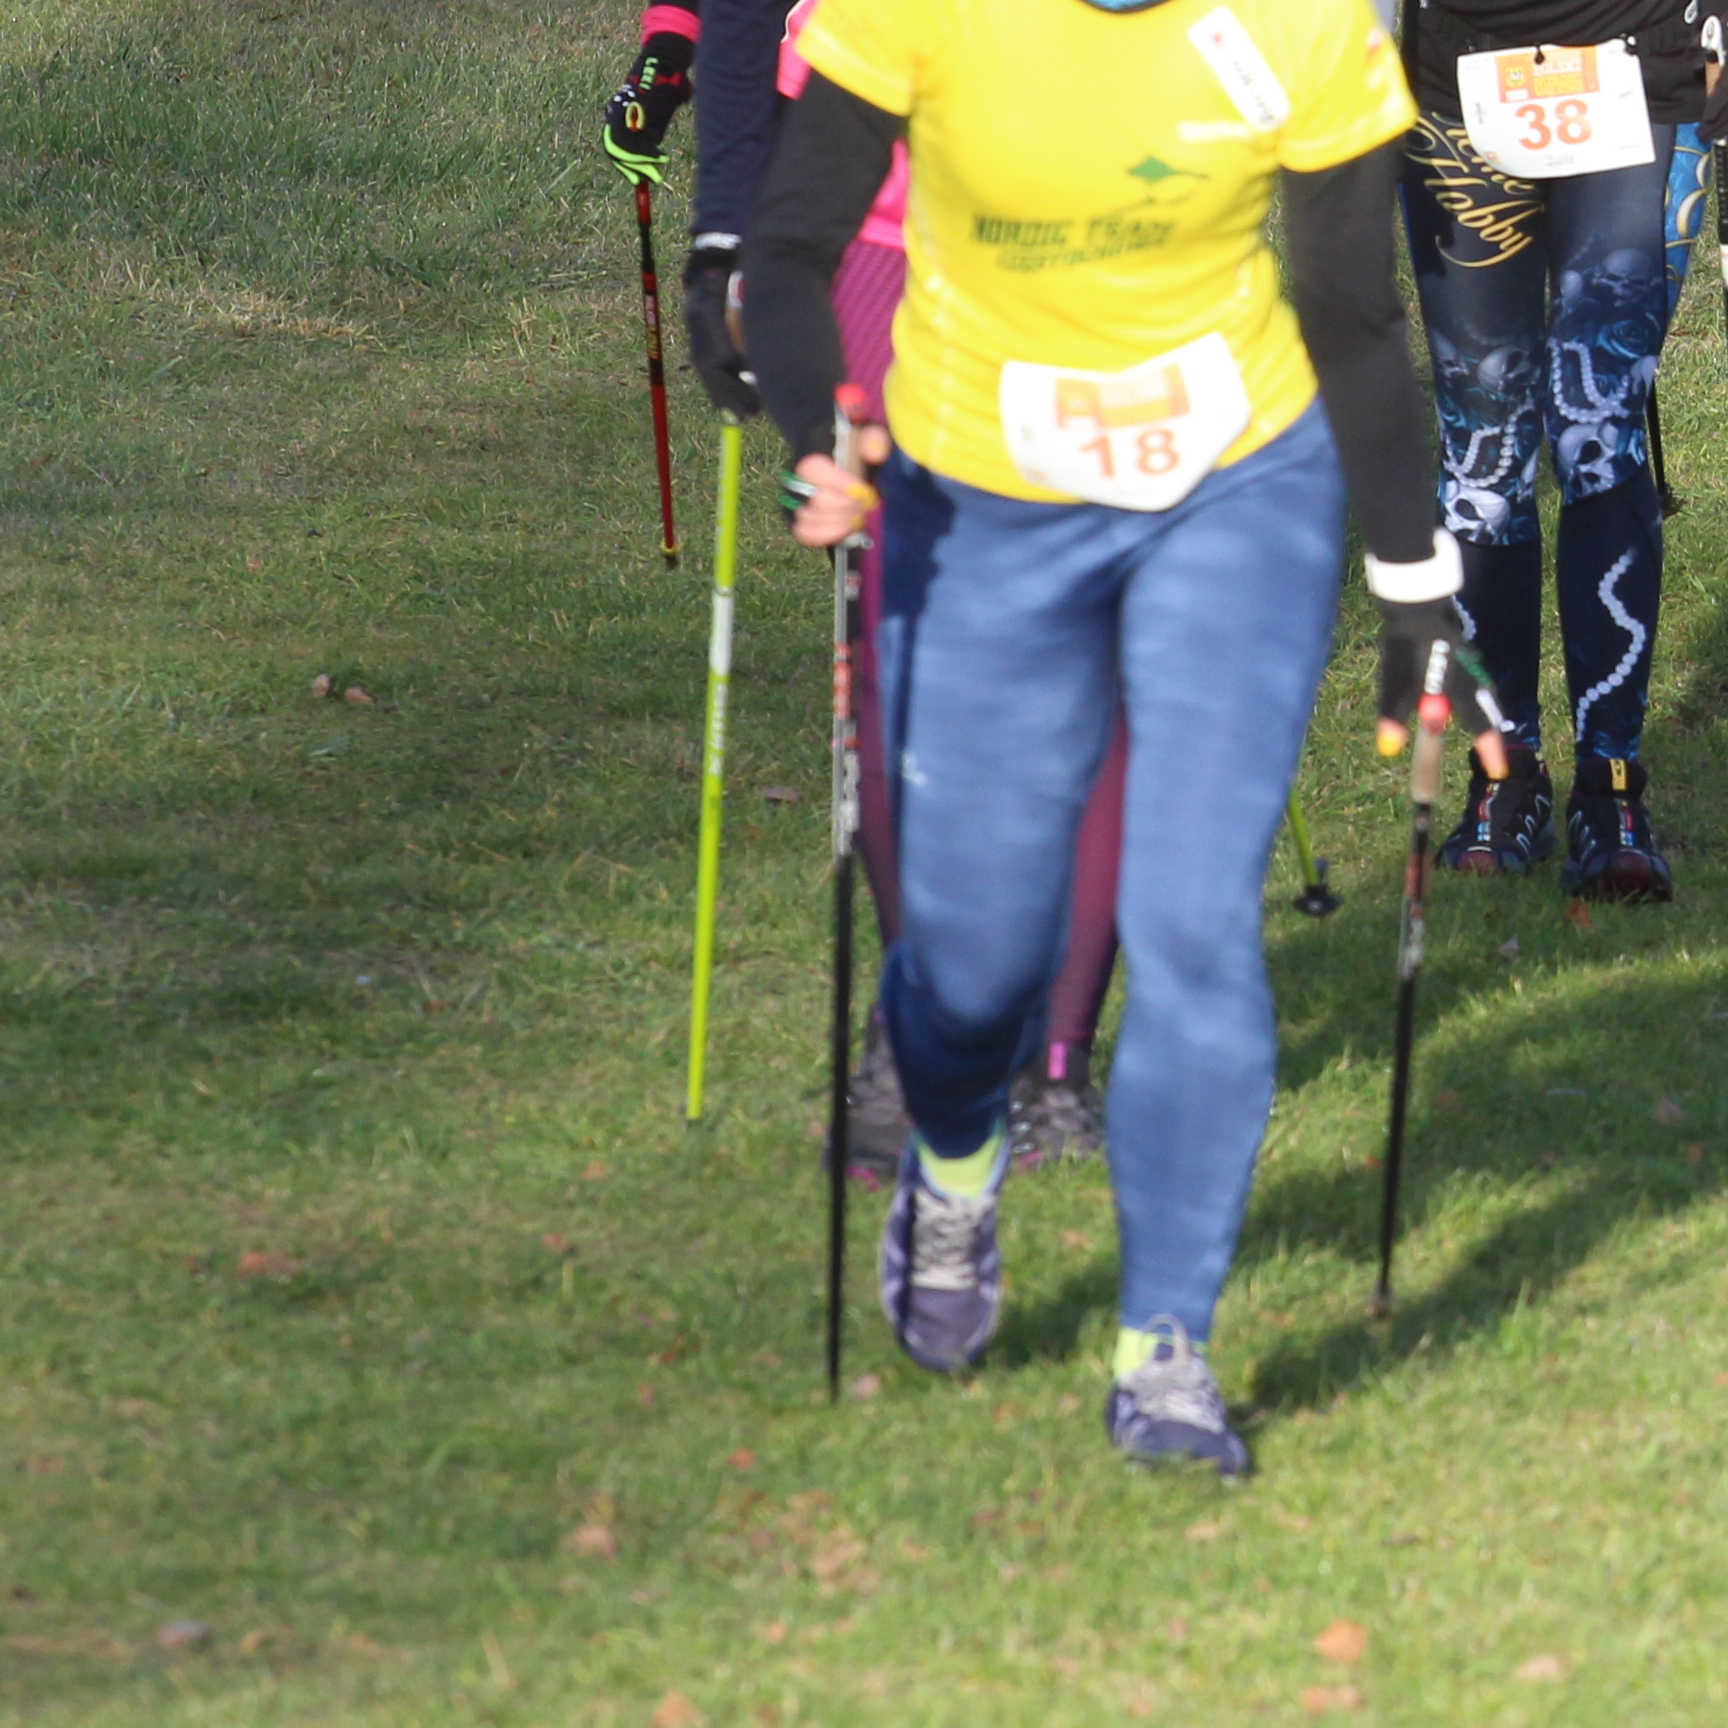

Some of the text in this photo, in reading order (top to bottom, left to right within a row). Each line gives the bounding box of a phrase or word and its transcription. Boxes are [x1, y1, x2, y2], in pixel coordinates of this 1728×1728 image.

[1514, 98, 1593, 151] 38
[1404, 115, 1546, 268] Hobby
[1080, 428, 1181, 478] 18
